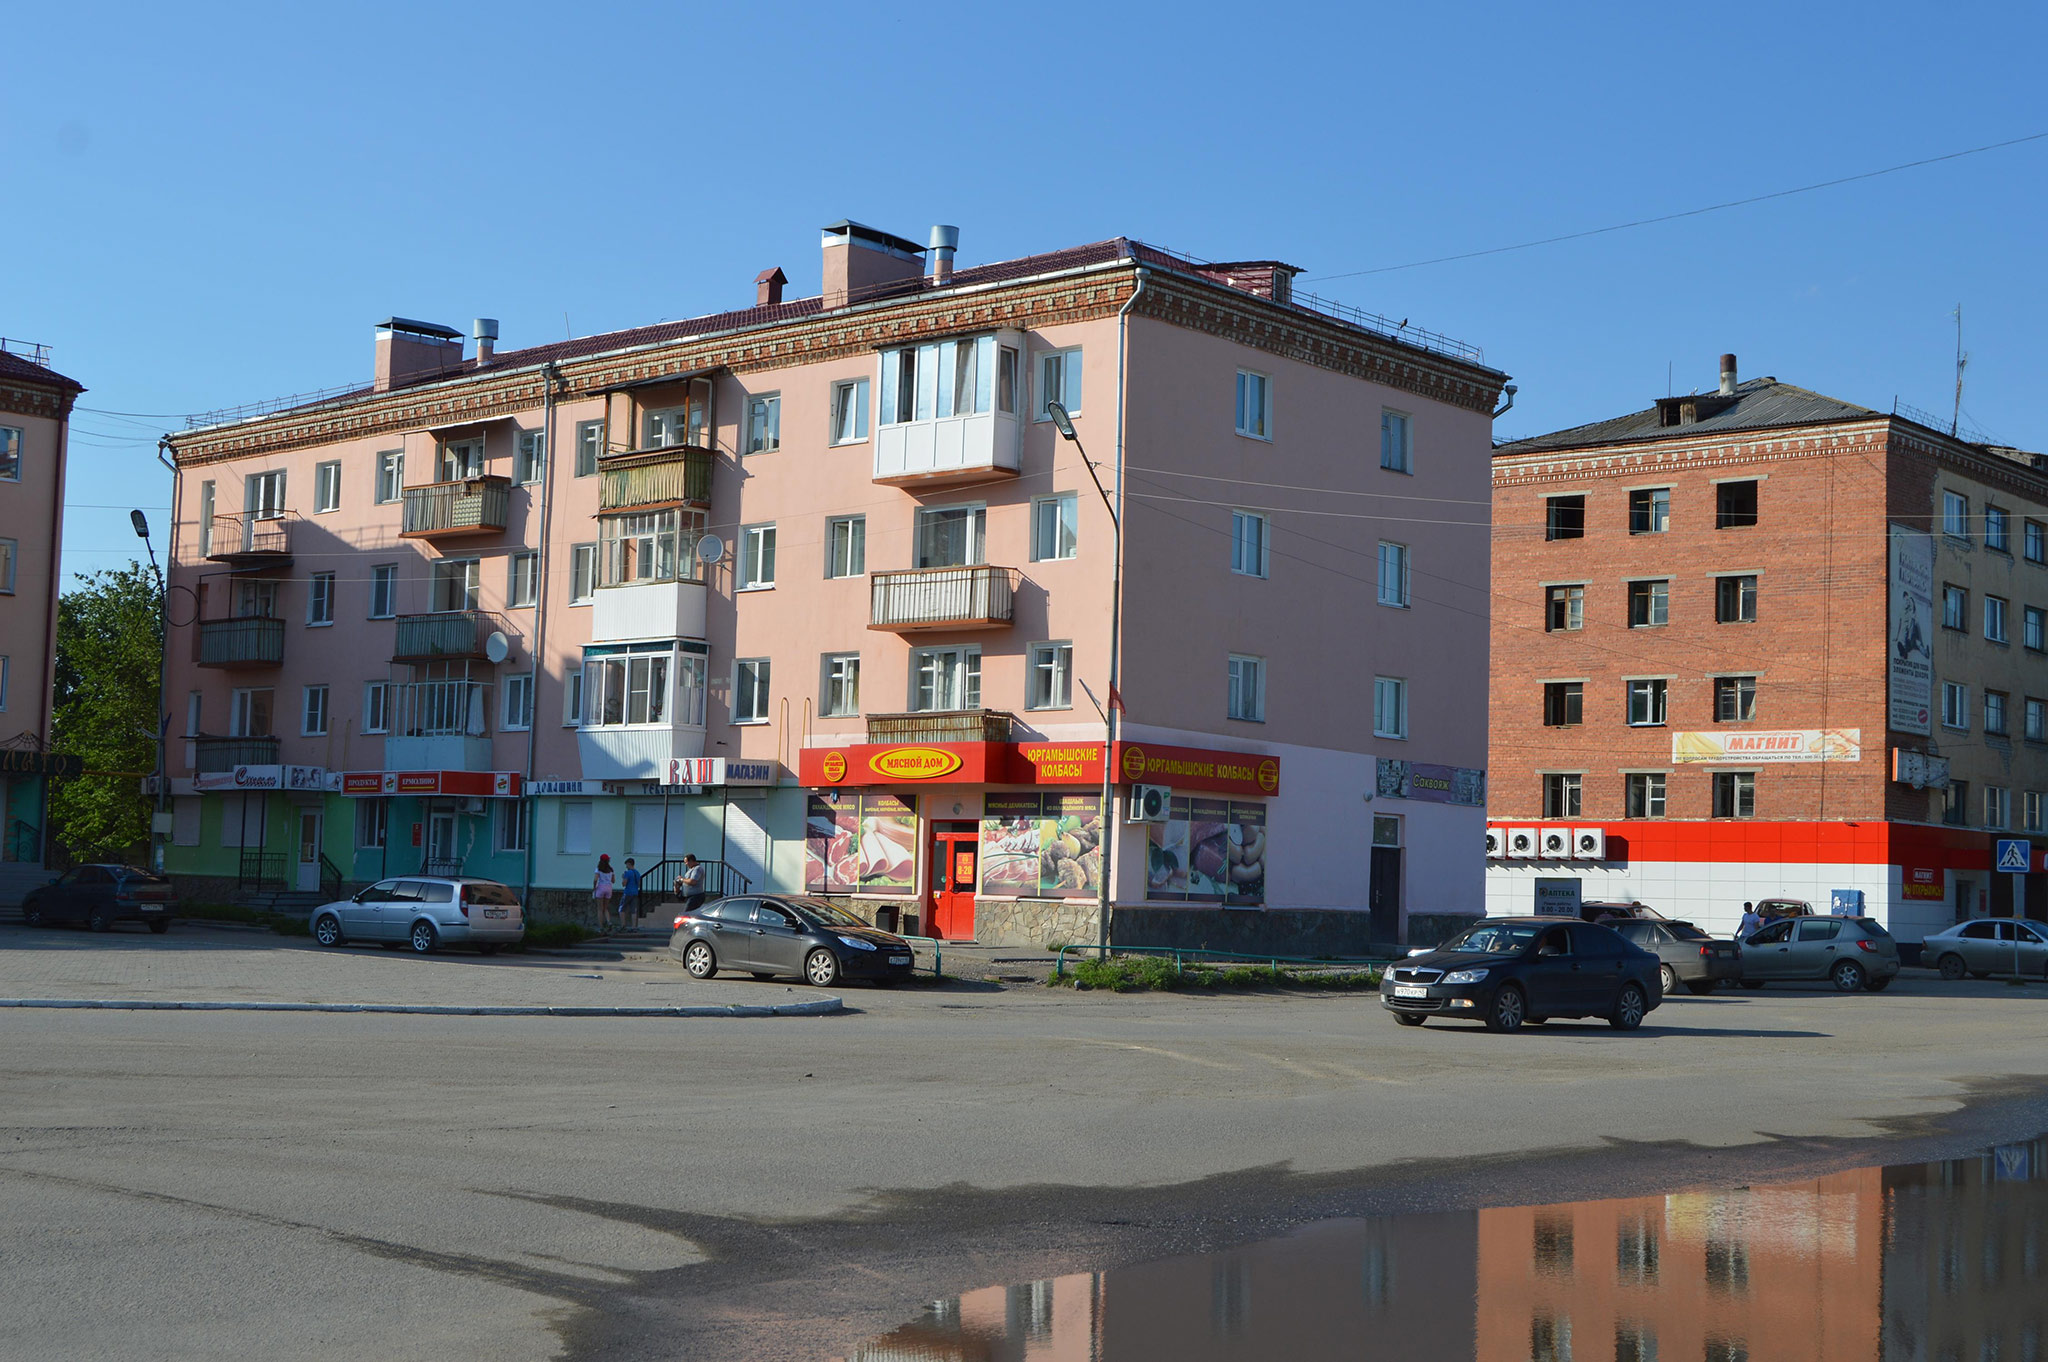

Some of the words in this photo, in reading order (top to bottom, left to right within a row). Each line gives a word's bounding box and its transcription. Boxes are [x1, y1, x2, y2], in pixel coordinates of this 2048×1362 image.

[1728, 736, 1800, 750] МАГНИТ
[1027, 748, 1098, 762] ЮРГАМЫШСКИЕ
[886, 756, 922, 769] МЯСНОЙ
[923, 757, 943, 769] ДОМ
[1147, 757, 1214, 778] ЮРГАМЫШСКИЕ
[1217, 764, 1255, 781] КОЛБАСЫ
[234, 766, 276, 787] Стиль
[669, 758, 714, 784] ВАШ
[727, 763, 770, 781] МАГАЗИН
[1041, 764, 1082, 777] КОЛБАСЫ
[348, 778, 378, 786] ПРОДУКТЫ
[402, 777, 435, 785] ЕРМОЛИНО
[1412, 773, 1450, 791] Саквояж
[957, 865, 972, 875] 8-20
